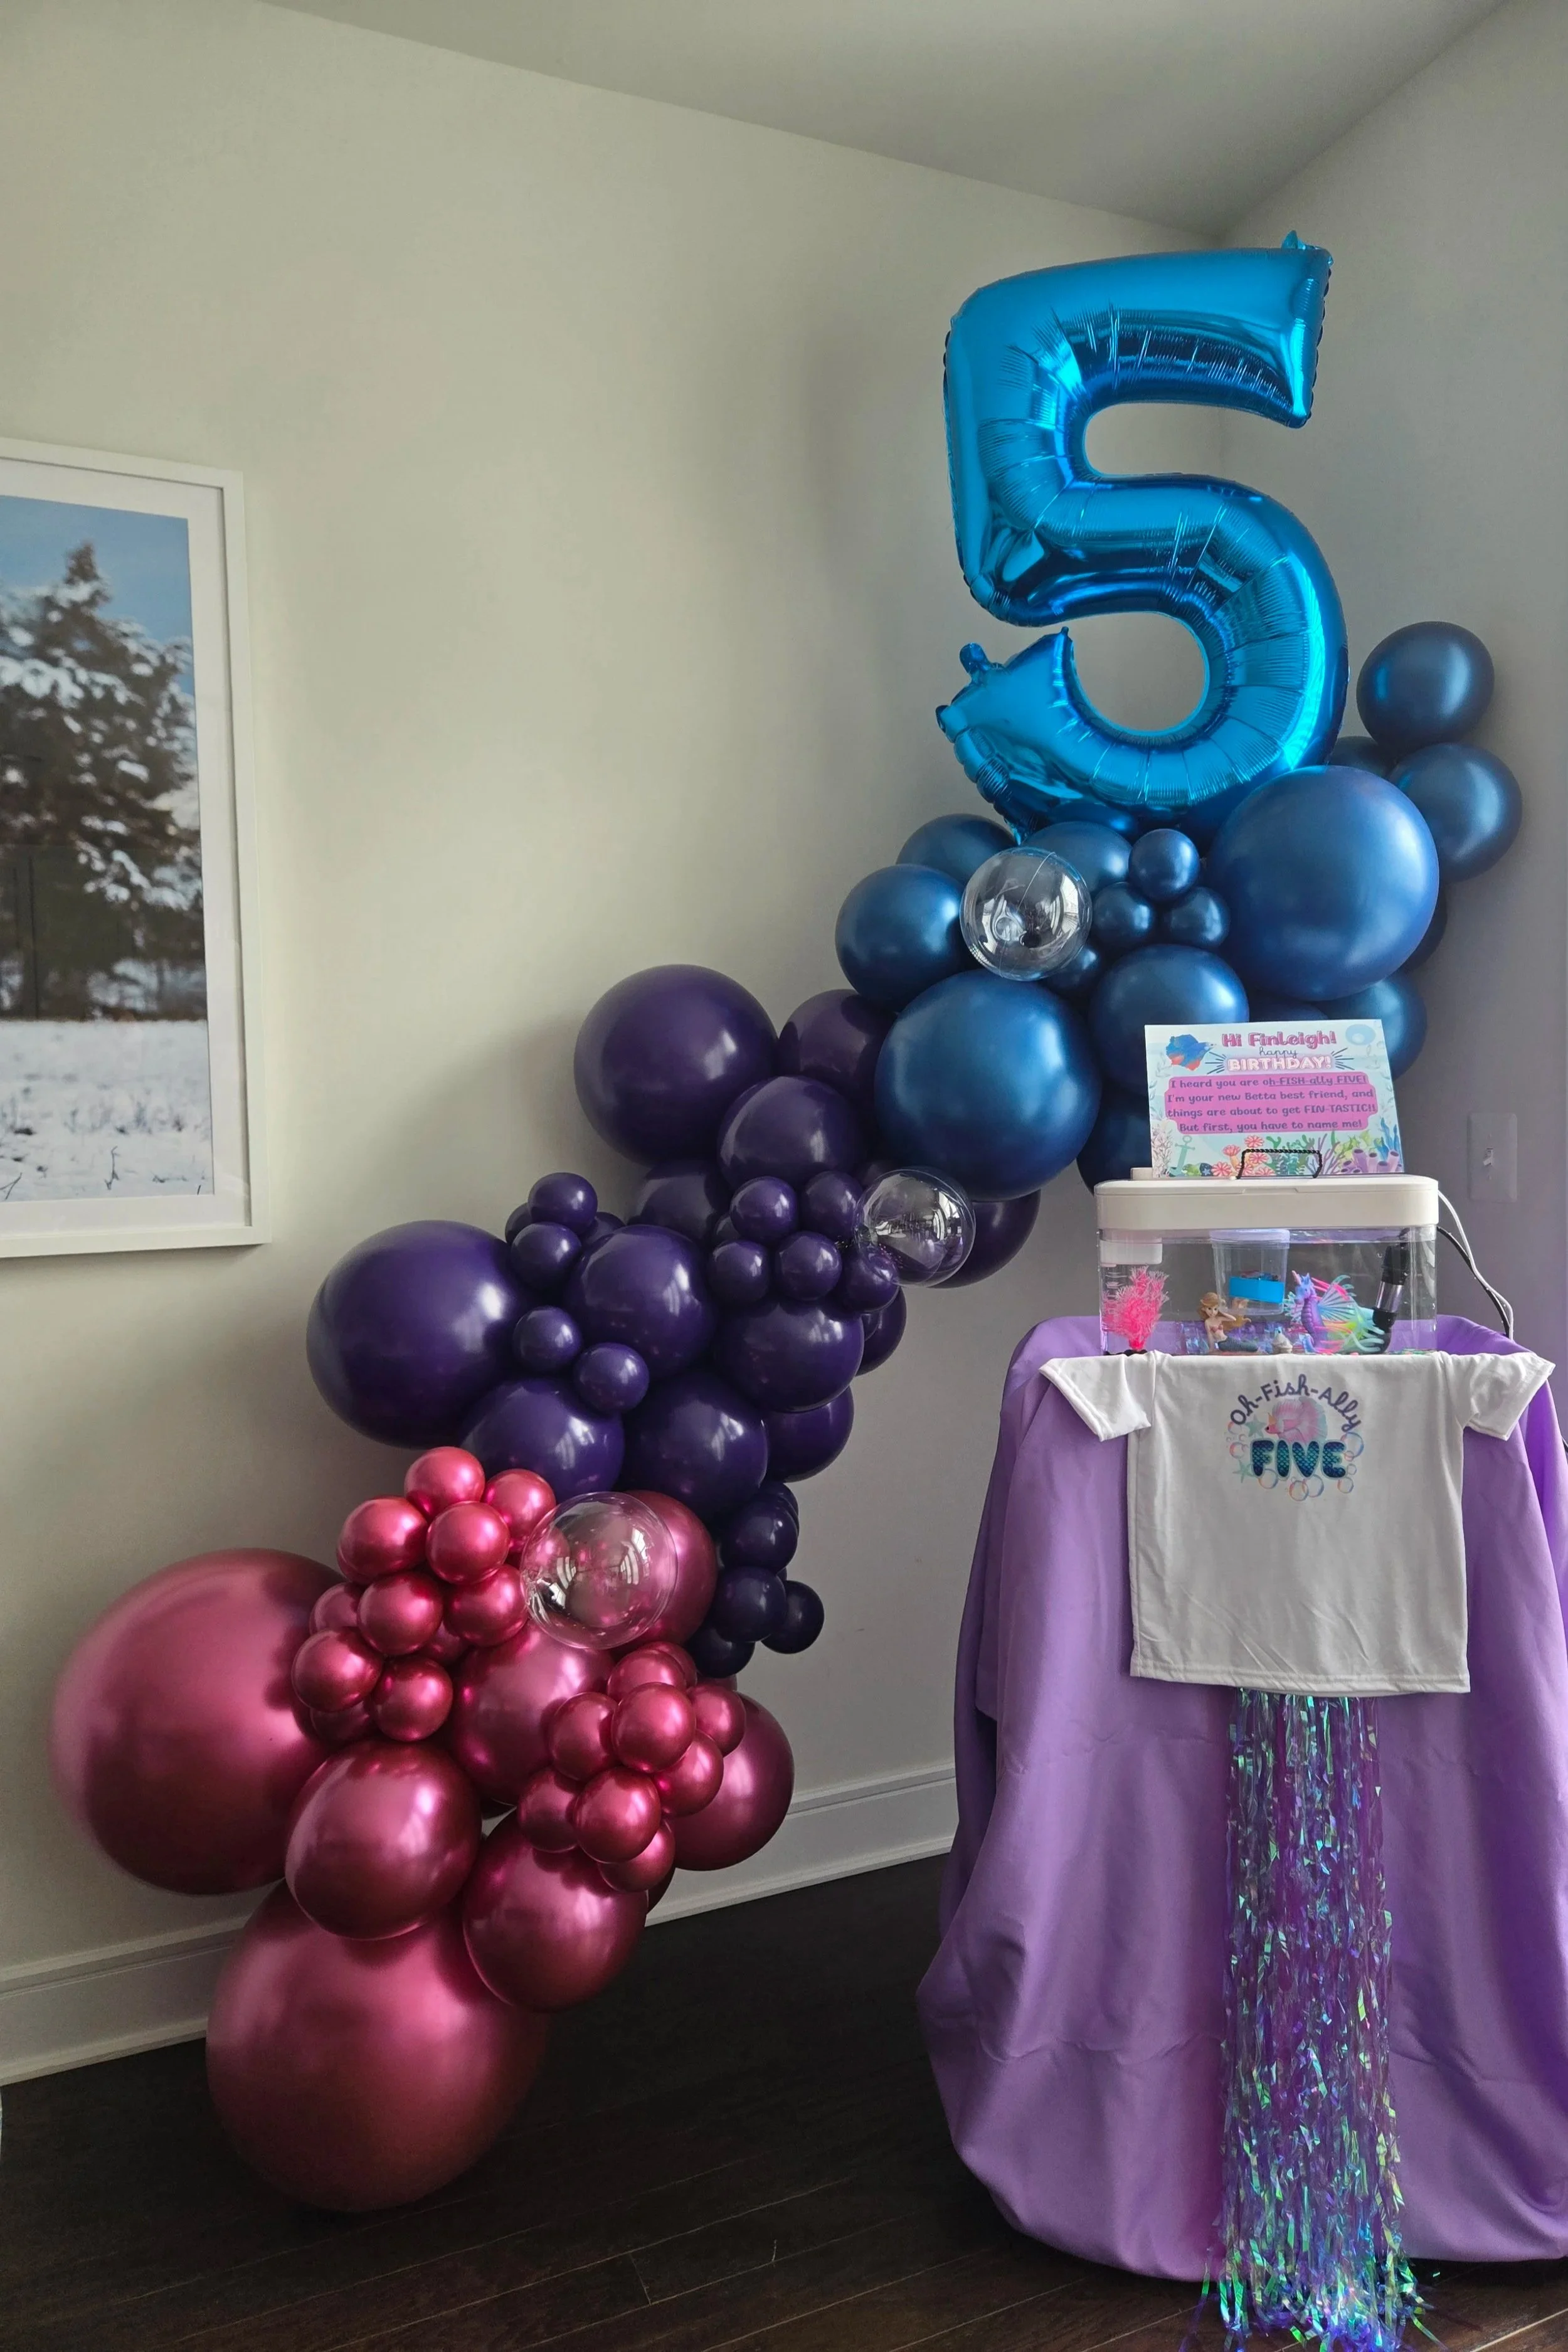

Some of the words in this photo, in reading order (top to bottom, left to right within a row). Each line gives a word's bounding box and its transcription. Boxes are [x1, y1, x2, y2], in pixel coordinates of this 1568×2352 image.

[936, 232, 1348, 845] 5
[1222, 1033, 1242, 1047] Hi
[1248, 1030, 1337, 1049] Finleigh!
[1259, 1046, 1298, 1058] happy
[1227, 1056, 1332, 1071] BIRTHDAY!
[1171, 1080, 1176, 1088] I
[1180, 1079, 1212, 1088] heard
[1216, 1080, 1236, 1089] you
[1263, 1076, 1333, 1087] oh-FISH-ally
[1337, 1075, 1366, 1084] FIVE!
[1167, 1094, 1185, 1103] I'm
[1189, 1095, 1214, 1104] your
[1280, 1091, 1305, 1099] best
[1309, 1089, 1348, 1100] friend,
[1352, 1089, 1373, 1098] and
[1167, 1109, 1203, 1119] things
[1230, 1107, 1263, 1115] about
[1282, 1106, 1301, 1116] get
[1304, 1103, 1376, 1113] FIN-TASTIC!!
[1179, 1123, 1199, 1131] But
[1203, 1123, 1232, 1133] first,
[1237, 1123, 1257, 1133] you
[1261, 1121, 1288, 1130] have
[1342, 1120, 1362, 1128] me!
[1230, 1374, 1362, 1433] Oh-Fish-Ally
[1251, 1439, 1347, 1478] FIVE
